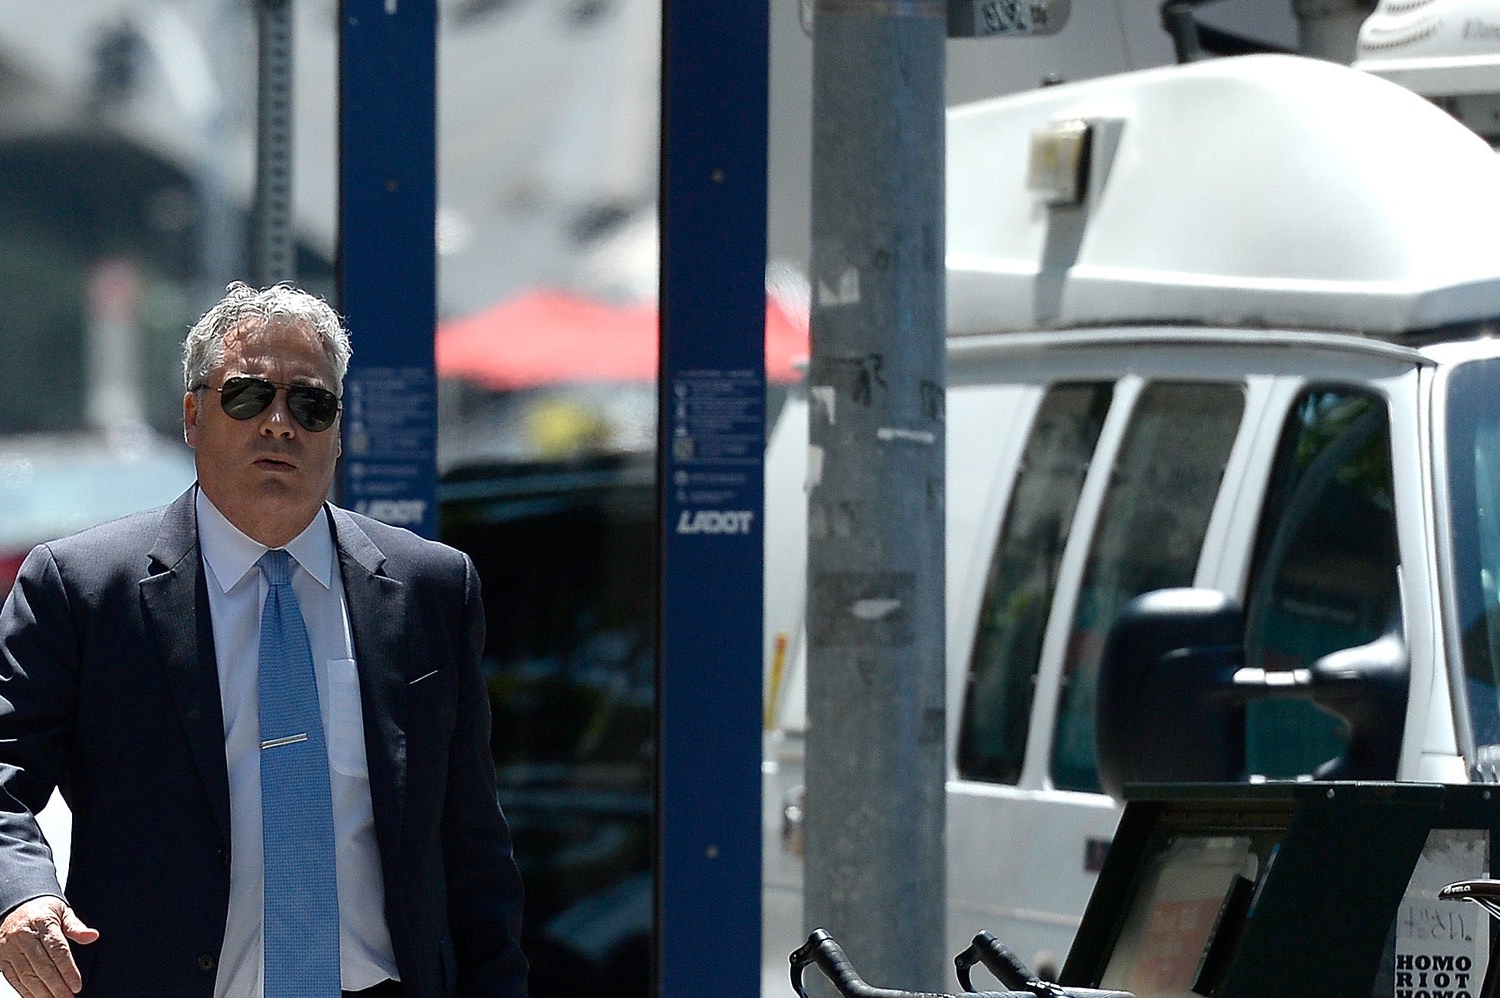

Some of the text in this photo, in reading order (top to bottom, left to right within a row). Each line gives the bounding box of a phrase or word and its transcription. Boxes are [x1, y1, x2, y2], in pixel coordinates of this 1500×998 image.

[675, 510, 753, 534] LADOT
[1396, 954, 1472, 971] HOMO
[1396, 972, 1470, 988] RIOT
